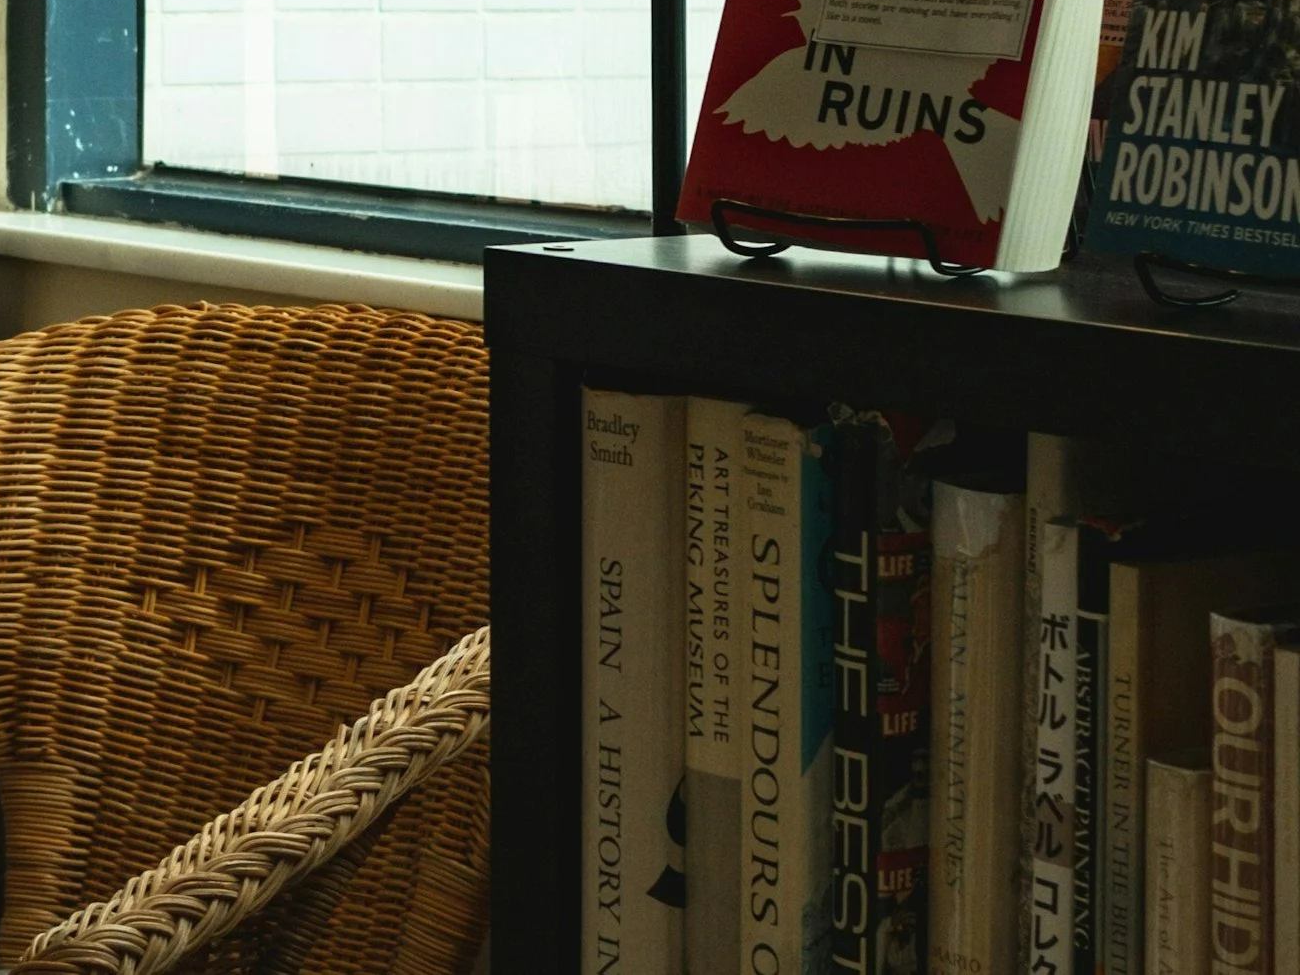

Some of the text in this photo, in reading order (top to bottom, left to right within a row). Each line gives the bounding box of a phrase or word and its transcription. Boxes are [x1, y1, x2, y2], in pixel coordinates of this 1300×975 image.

[804, 29, 856, 76] IN
[1136, 7, 1209, 71] KIM
[818, 80, 988, 144] RUINS
[1122, 75, 1286, 149] STANLEY
[1110, 142, 1300, 223] ROBINSON
[1105, 211, 1230, 239] NEW YORK TIMES
[587, 411, 640, 443] Bradley
[591, 441, 633, 466] Smith
[687, 443, 704, 738] PEKING MUSEUM
[713, 448, 729, 744] ART TREASURES OF THE
[877, 554, 913, 577] LIFE
[598, 557, 623, 924] SPAIN A HISTORY
[750, 534, 780, 927] SPLENDOURS
[882, 710, 918, 736] LIFE
[1035, 614, 1069, 859] ボトル ラベル
